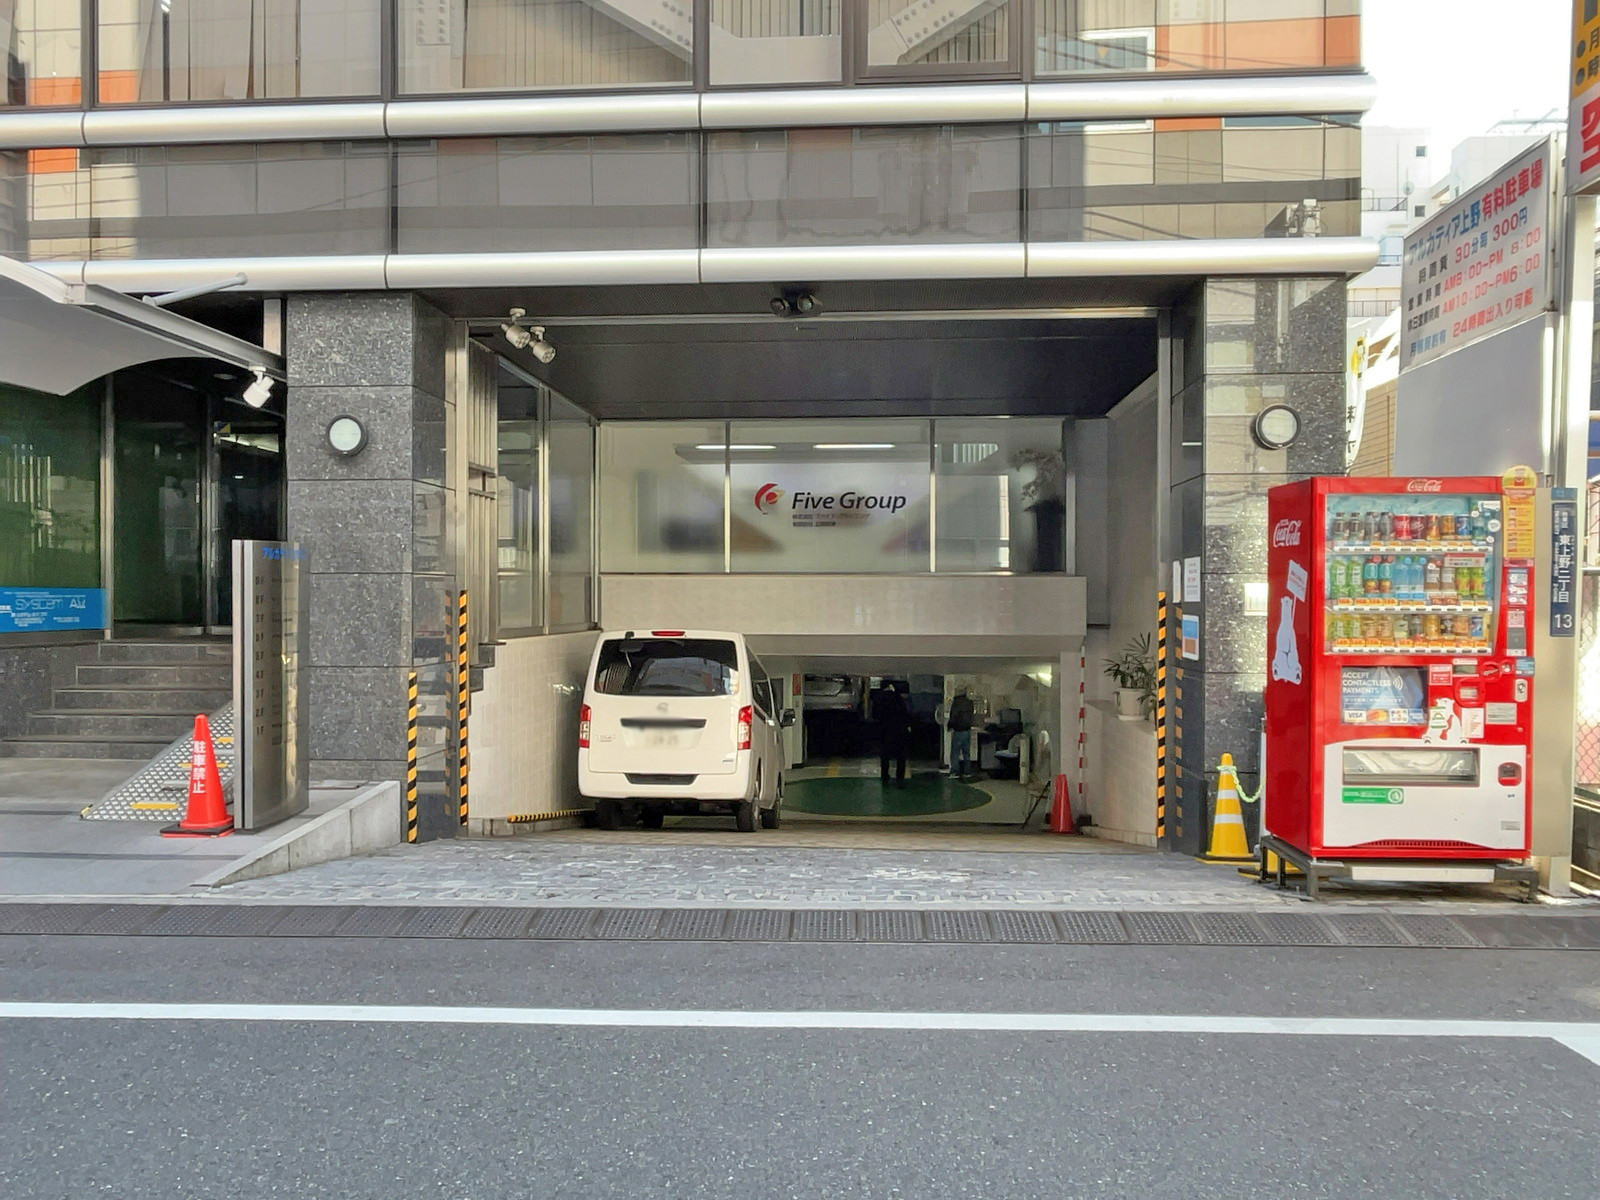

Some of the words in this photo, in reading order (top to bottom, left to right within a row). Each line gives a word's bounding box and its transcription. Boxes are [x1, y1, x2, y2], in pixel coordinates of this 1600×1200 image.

[792, 492, 835, 510] Five
[839, 491, 907, 513] Group
[1558, 535, 1571, 603] 東上野二丁目
[1554, 614, 1573, 629] 13
